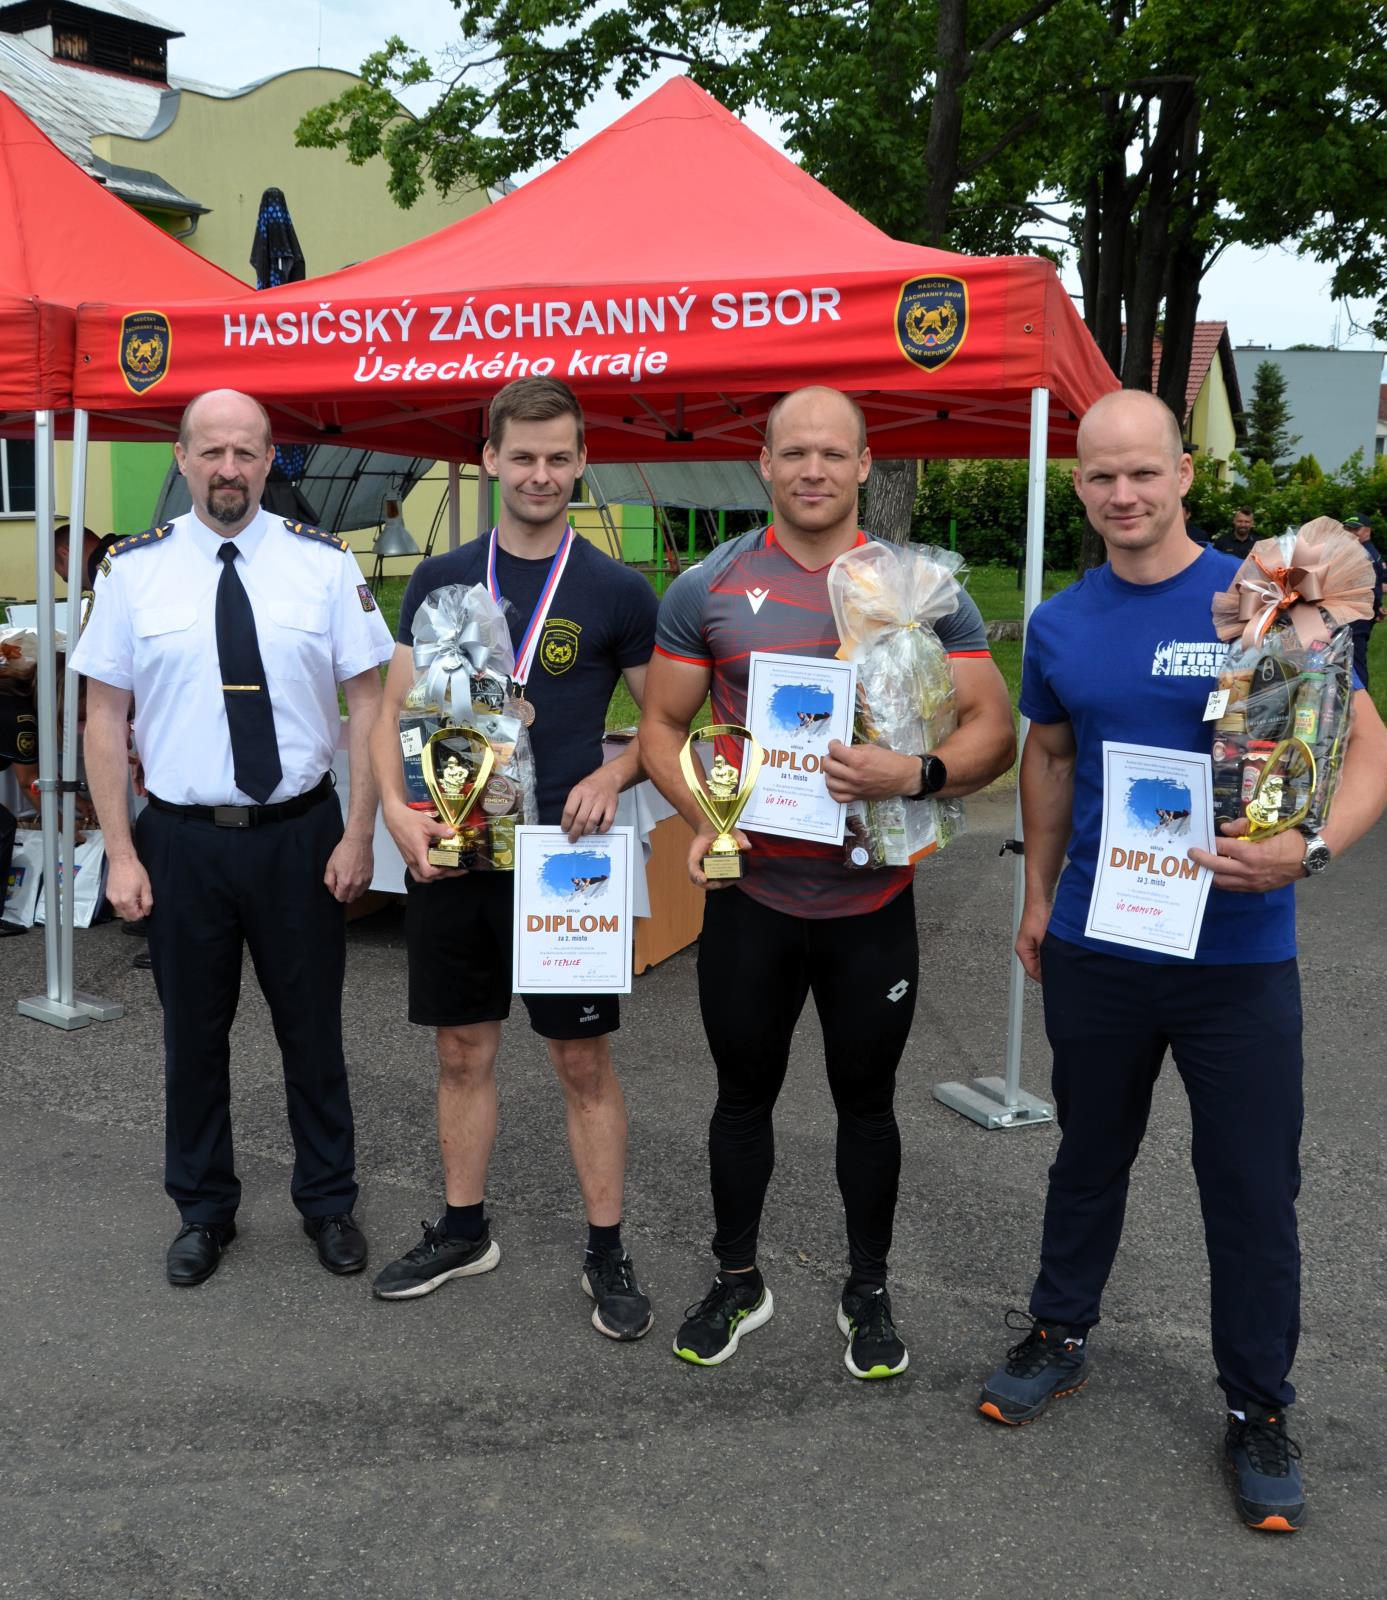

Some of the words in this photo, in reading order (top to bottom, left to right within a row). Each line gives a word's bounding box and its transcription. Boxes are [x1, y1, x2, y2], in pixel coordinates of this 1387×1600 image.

[223, 299, 418, 347] HASIČSKÝ
[429, 286, 697, 341] ZÁCHRANNÝ
[711, 287, 841, 330] SBOR
[353, 346, 556, 382] Ústeckého
[568, 346, 668, 382] kraje
[1176, 642, 1230, 654] CHOMUTOV
[1173, 665, 1220, 677] RESCU
[1110, 847, 1201, 881] DIPLOM
[527, 914, 619, 933] DIPLOM
